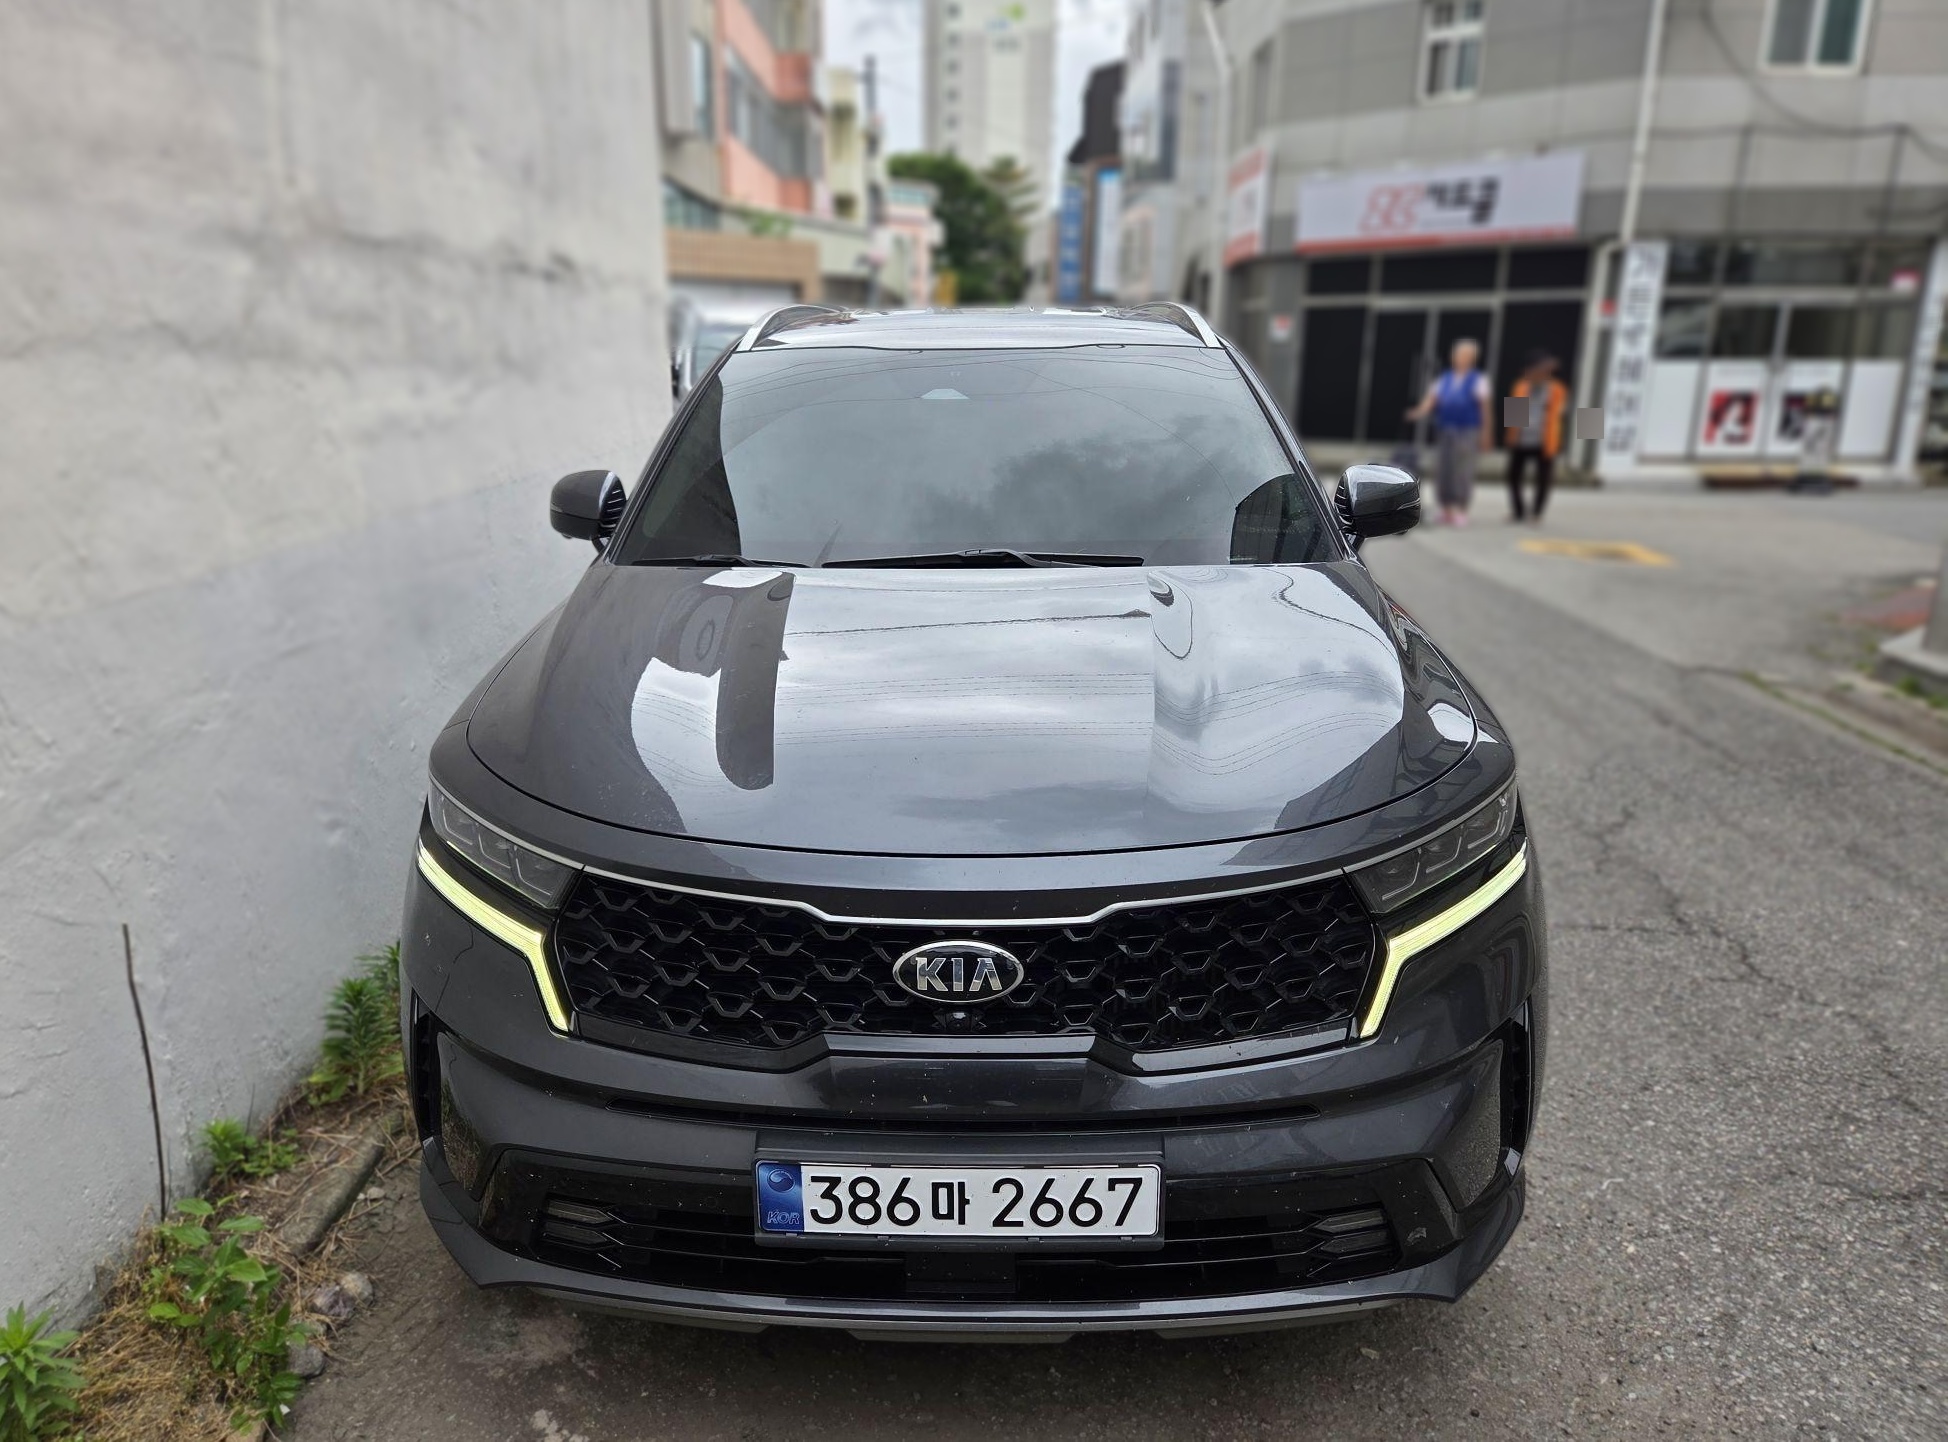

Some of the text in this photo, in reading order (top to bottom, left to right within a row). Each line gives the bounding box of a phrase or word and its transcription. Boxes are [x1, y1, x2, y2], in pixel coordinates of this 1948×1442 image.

[915, 957, 1003, 992] KIA
[766, 1210, 801, 1225] KOR
[809, 1175, 1143, 1228] 386마 2667
